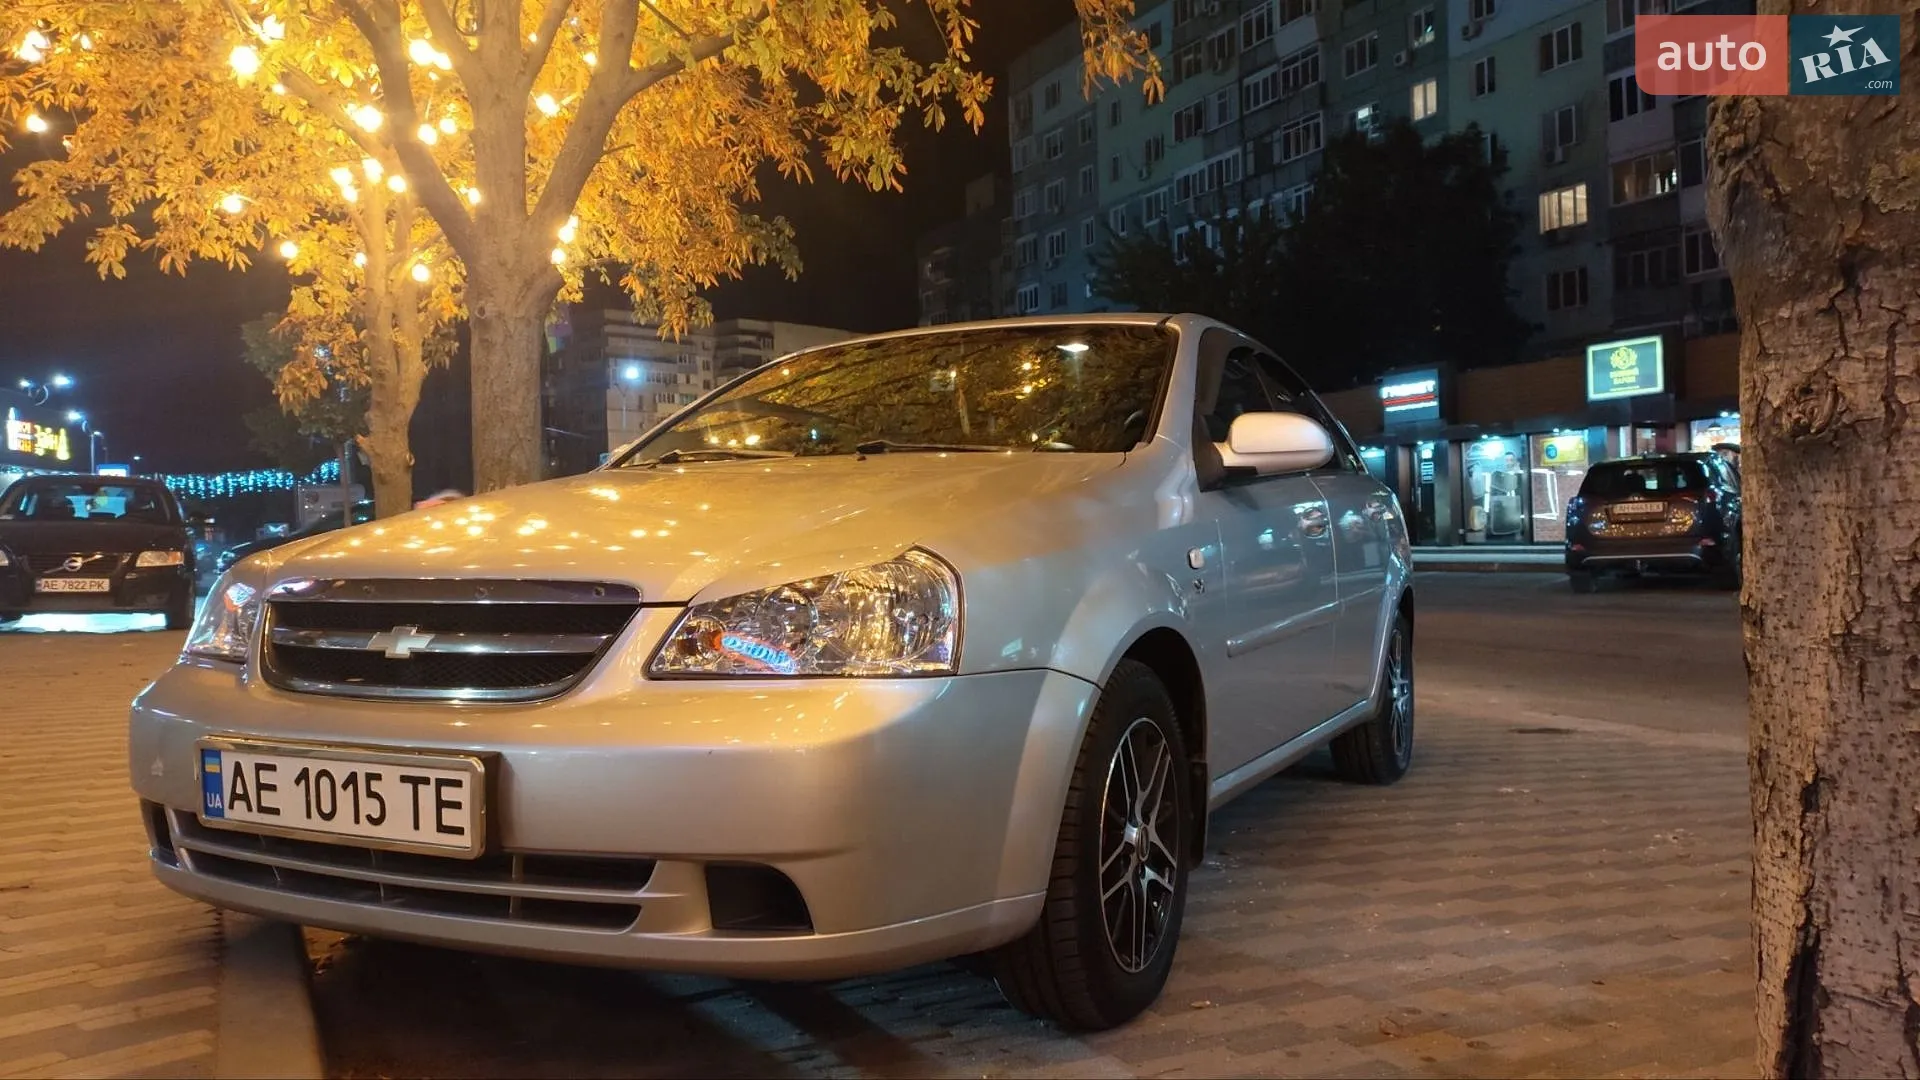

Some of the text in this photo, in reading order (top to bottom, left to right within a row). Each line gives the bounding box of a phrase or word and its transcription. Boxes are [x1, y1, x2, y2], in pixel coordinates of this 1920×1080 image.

[43, 580, 105, 590] AE 7822 PK
[207, 792, 222, 809] UA
[228, 761, 465, 835] AE 1015 TE
